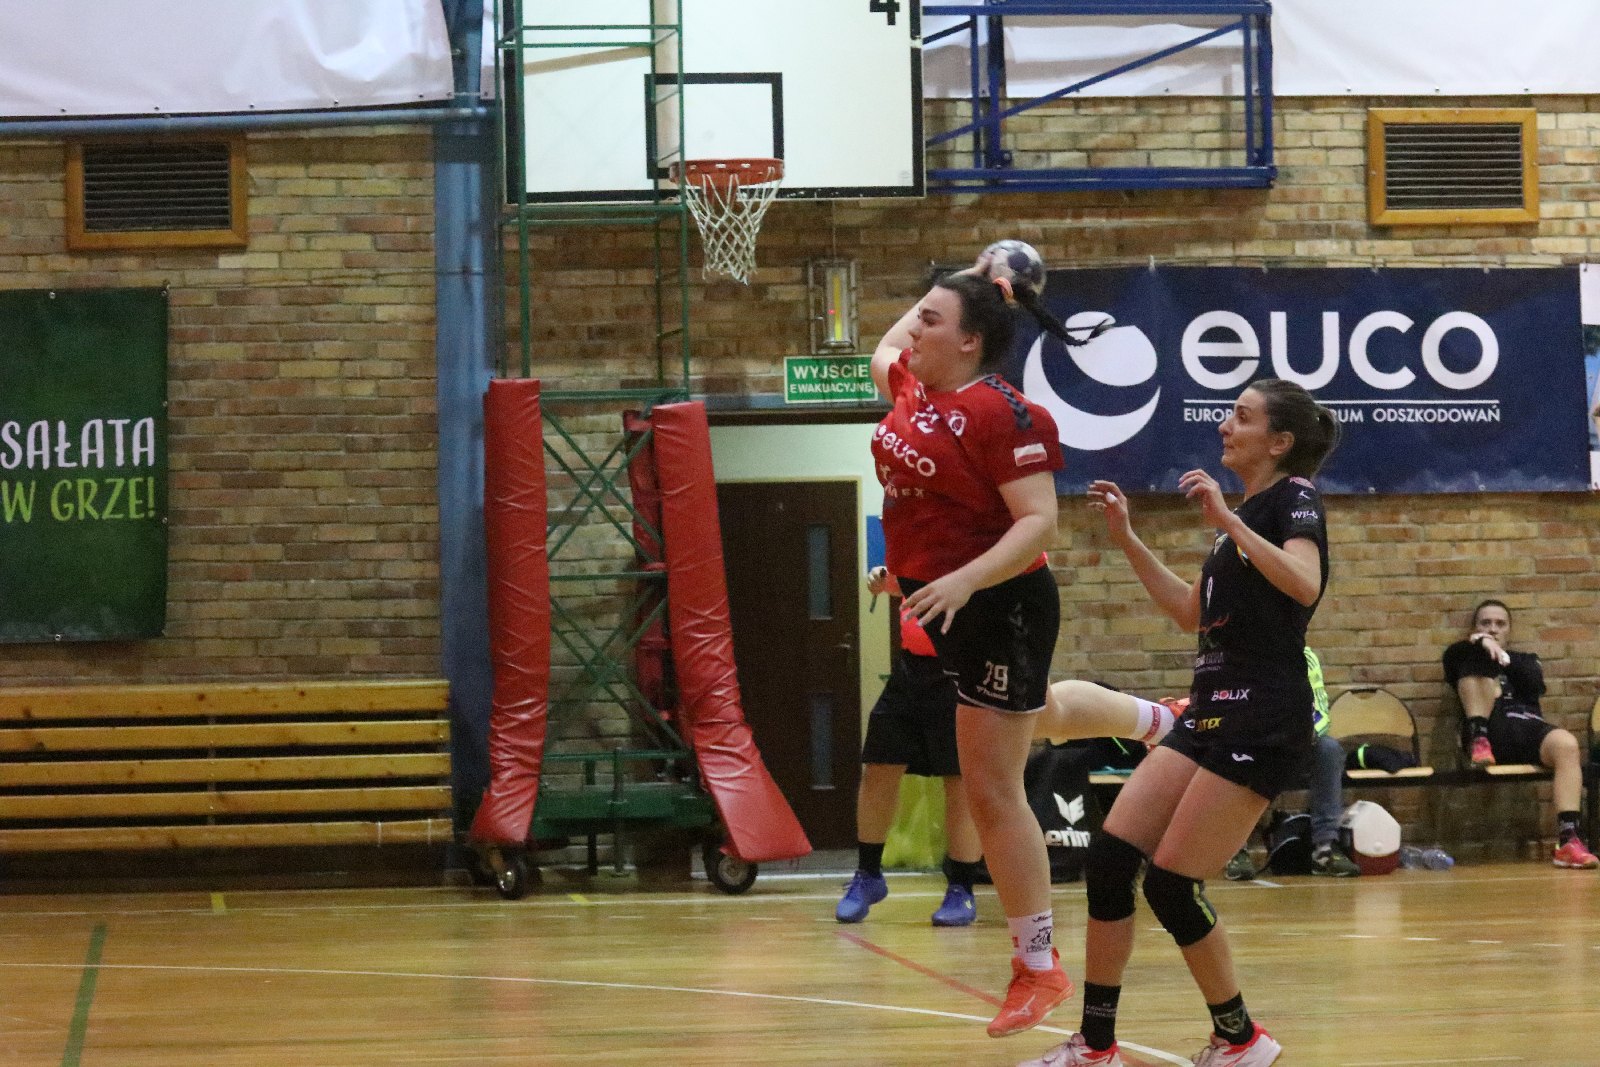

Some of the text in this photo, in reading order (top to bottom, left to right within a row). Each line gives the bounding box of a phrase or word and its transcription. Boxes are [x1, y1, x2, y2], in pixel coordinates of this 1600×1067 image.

[1180, 310, 1500, 391] euco
[1372, 404, 1500, 423] ODSZKODOWAŃ
[0, 416, 156, 471] SAŁATA
[1, 476, 156, 524] W GRZE!
